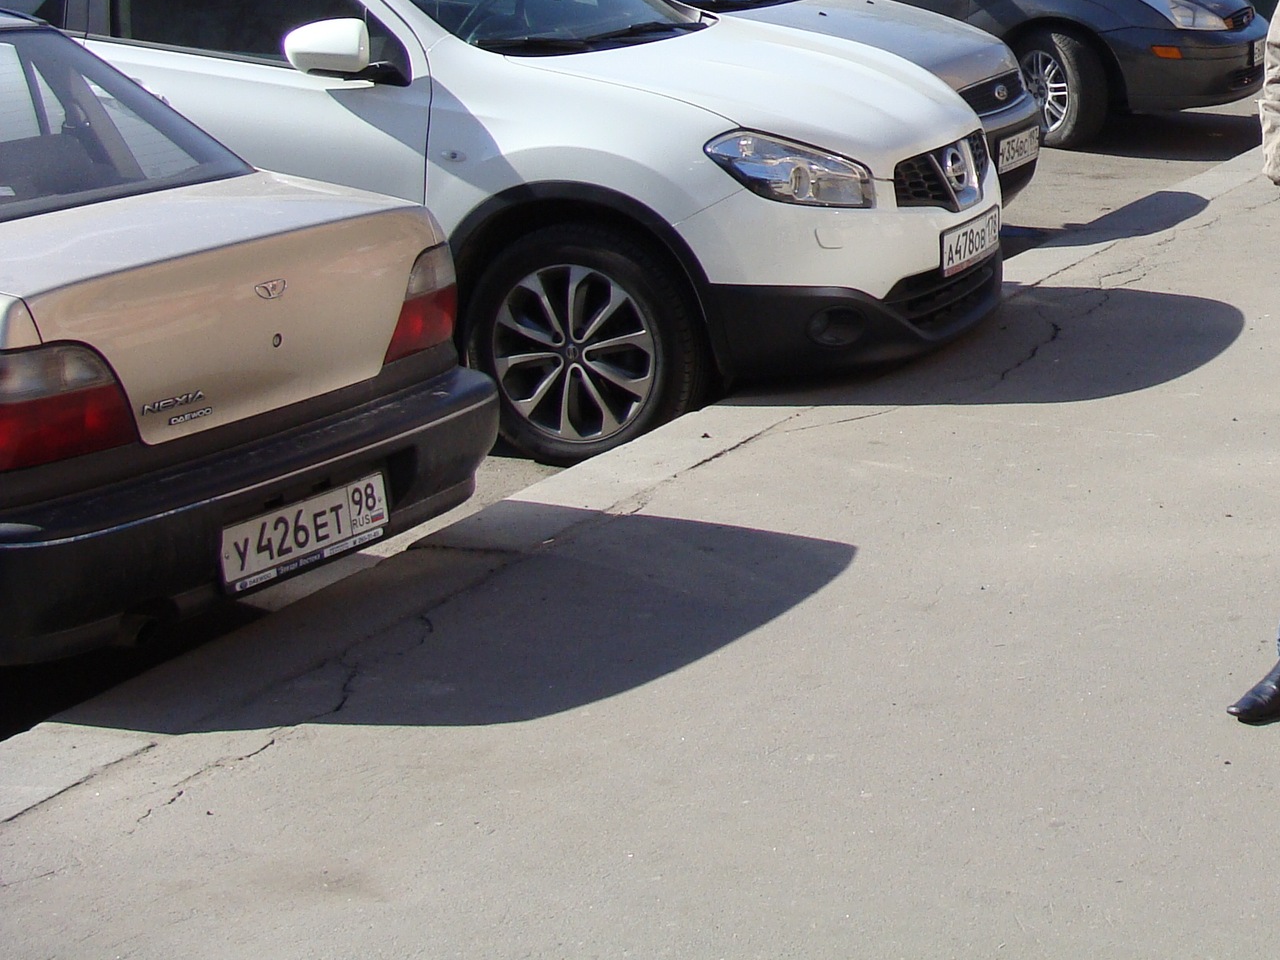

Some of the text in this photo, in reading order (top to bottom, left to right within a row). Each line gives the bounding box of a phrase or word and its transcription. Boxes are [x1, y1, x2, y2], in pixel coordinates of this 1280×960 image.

[142, 390, 205, 416] NEXIA
[170, 407, 212, 425] DAEWOO
[352, 482, 377, 517] 98
[352, 514, 371, 530] RUS
